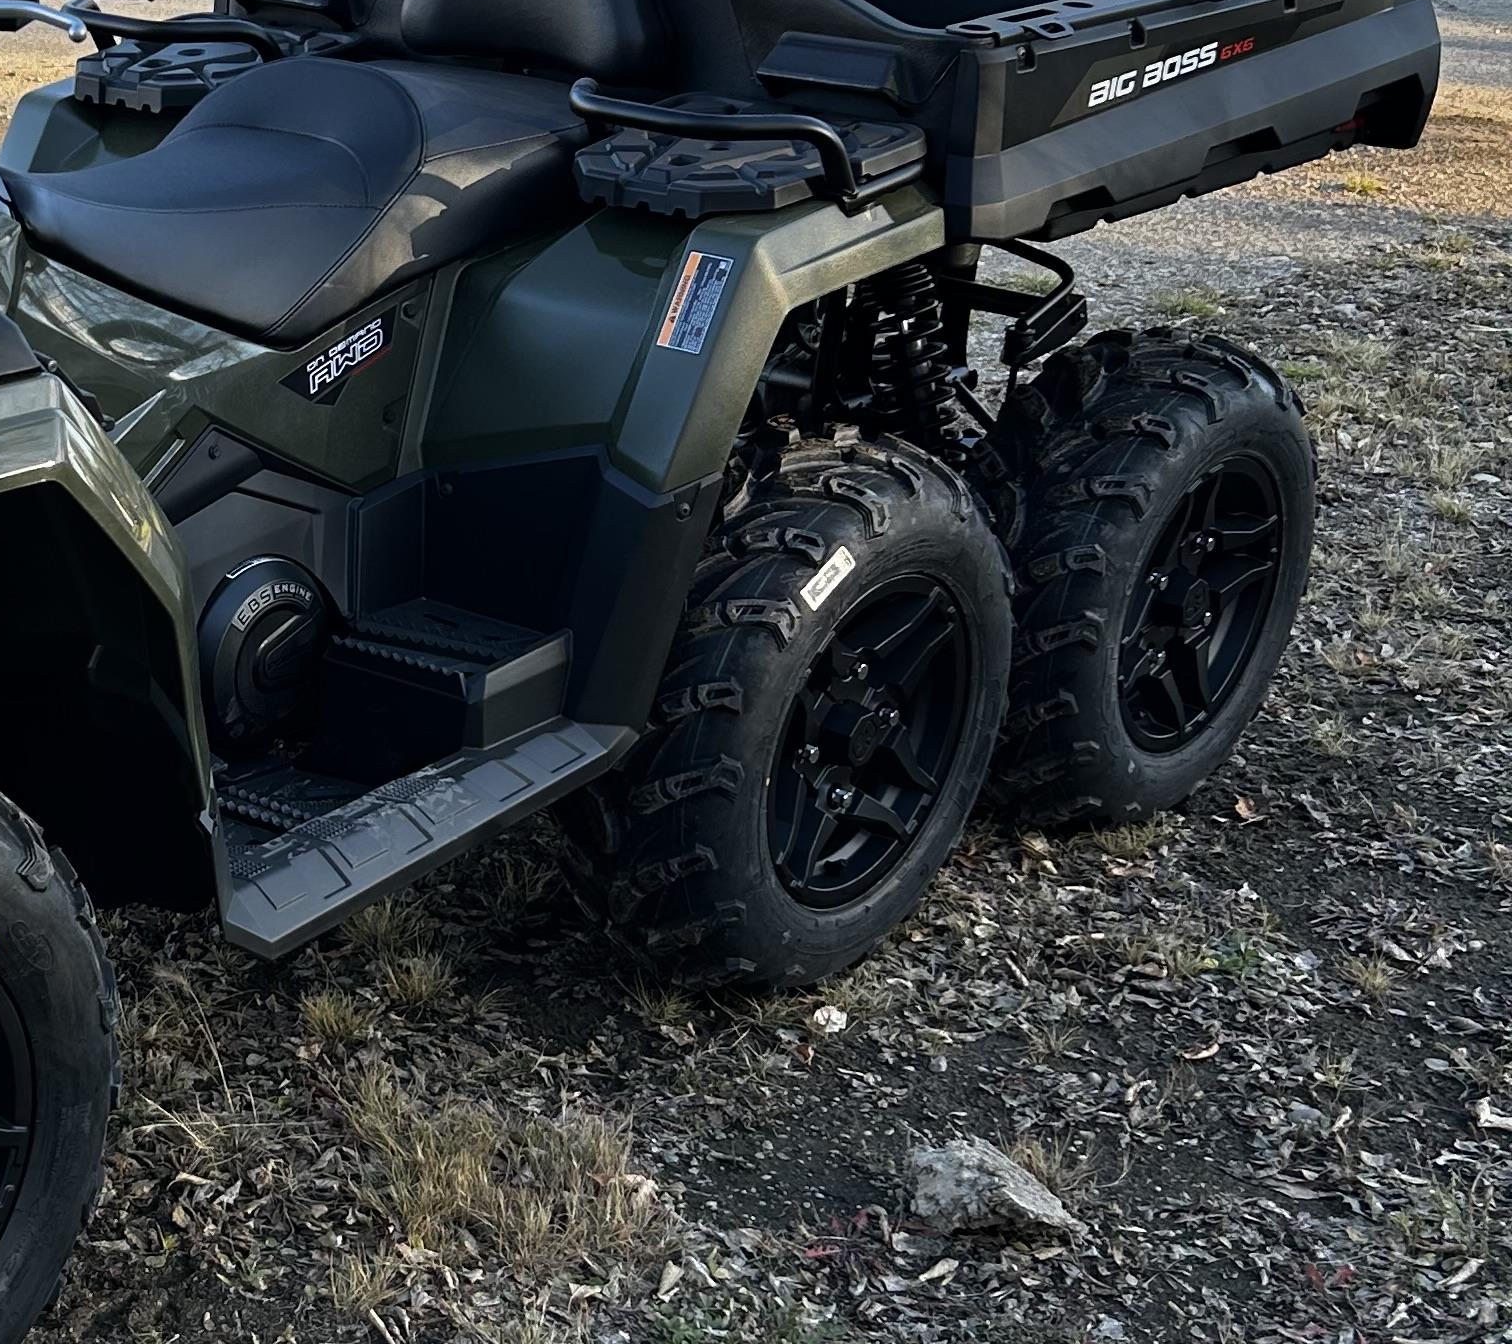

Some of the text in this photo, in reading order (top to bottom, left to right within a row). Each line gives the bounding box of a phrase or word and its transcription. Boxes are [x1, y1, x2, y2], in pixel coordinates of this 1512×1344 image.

[1088, 70, 1138, 107] BIG
[1142, 42, 1219, 88] BOSS
[309, 328, 383, 394] AWD
[237, 583, 313, 625] EBS ENGINE
